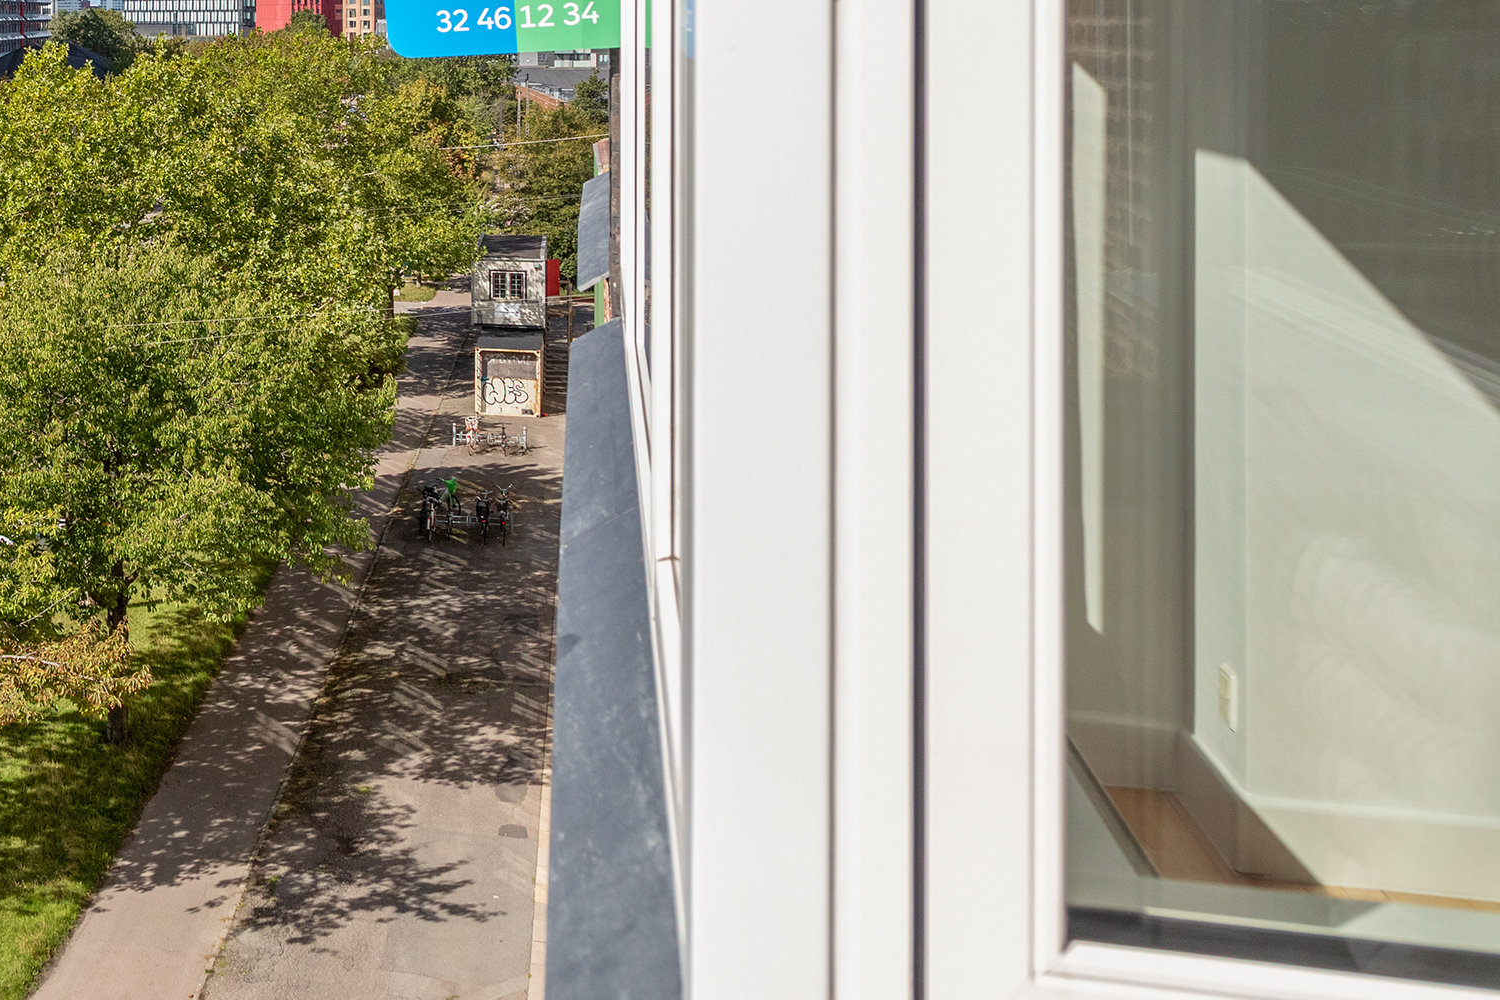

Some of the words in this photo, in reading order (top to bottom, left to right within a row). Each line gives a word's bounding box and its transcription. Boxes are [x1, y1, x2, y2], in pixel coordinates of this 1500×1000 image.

[436, 9, 470, 33] 32
[477, 6, 512, 30] 46
[519, 3, 555, 28] 12
[563, 1, 600, 26] 34
